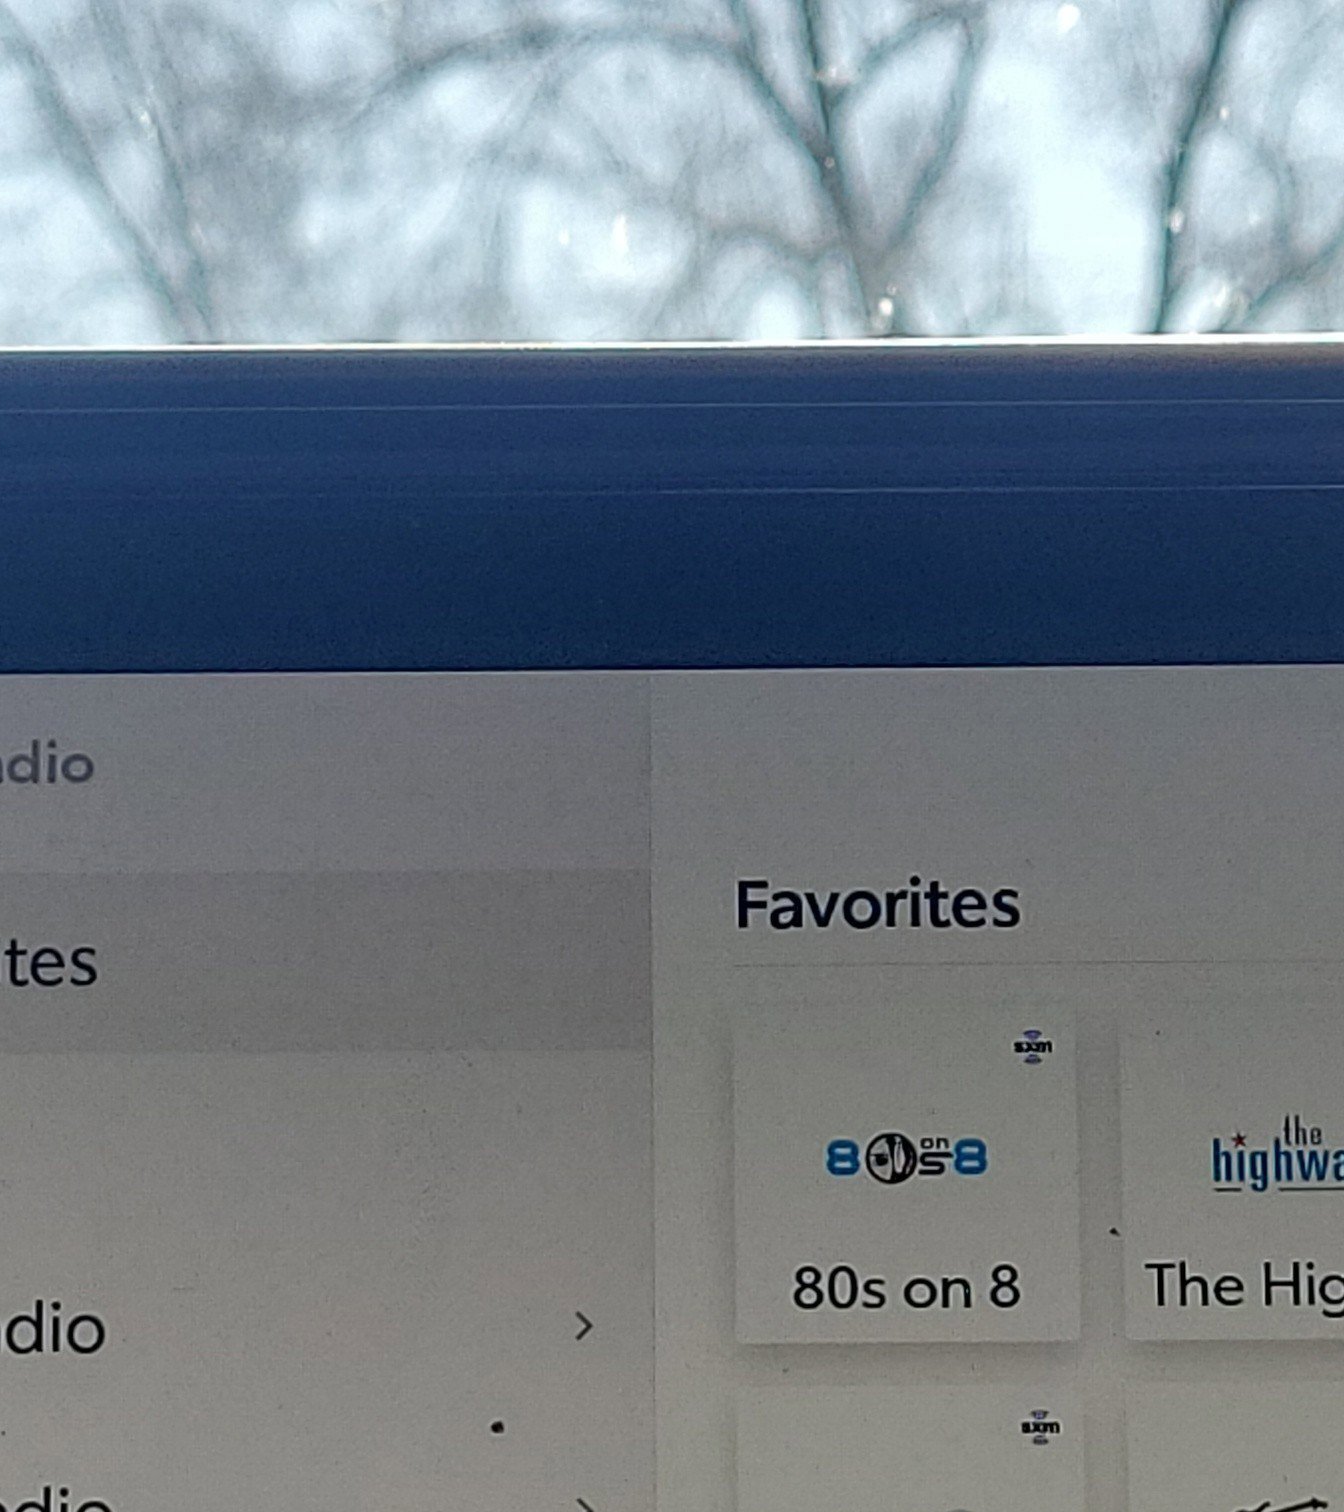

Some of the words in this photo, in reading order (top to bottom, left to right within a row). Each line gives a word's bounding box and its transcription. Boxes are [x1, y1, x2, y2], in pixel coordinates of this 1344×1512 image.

[738, 875, 1020, 930] Favorites
[1283, 1113, 1323, 1146] the
[793, 1265, 886, 1310] 80s
[903, 1277, 972, 1309] on
[989, 1264, 1021, 1309] 8
[1144, 1260, 1244, 1307] The
